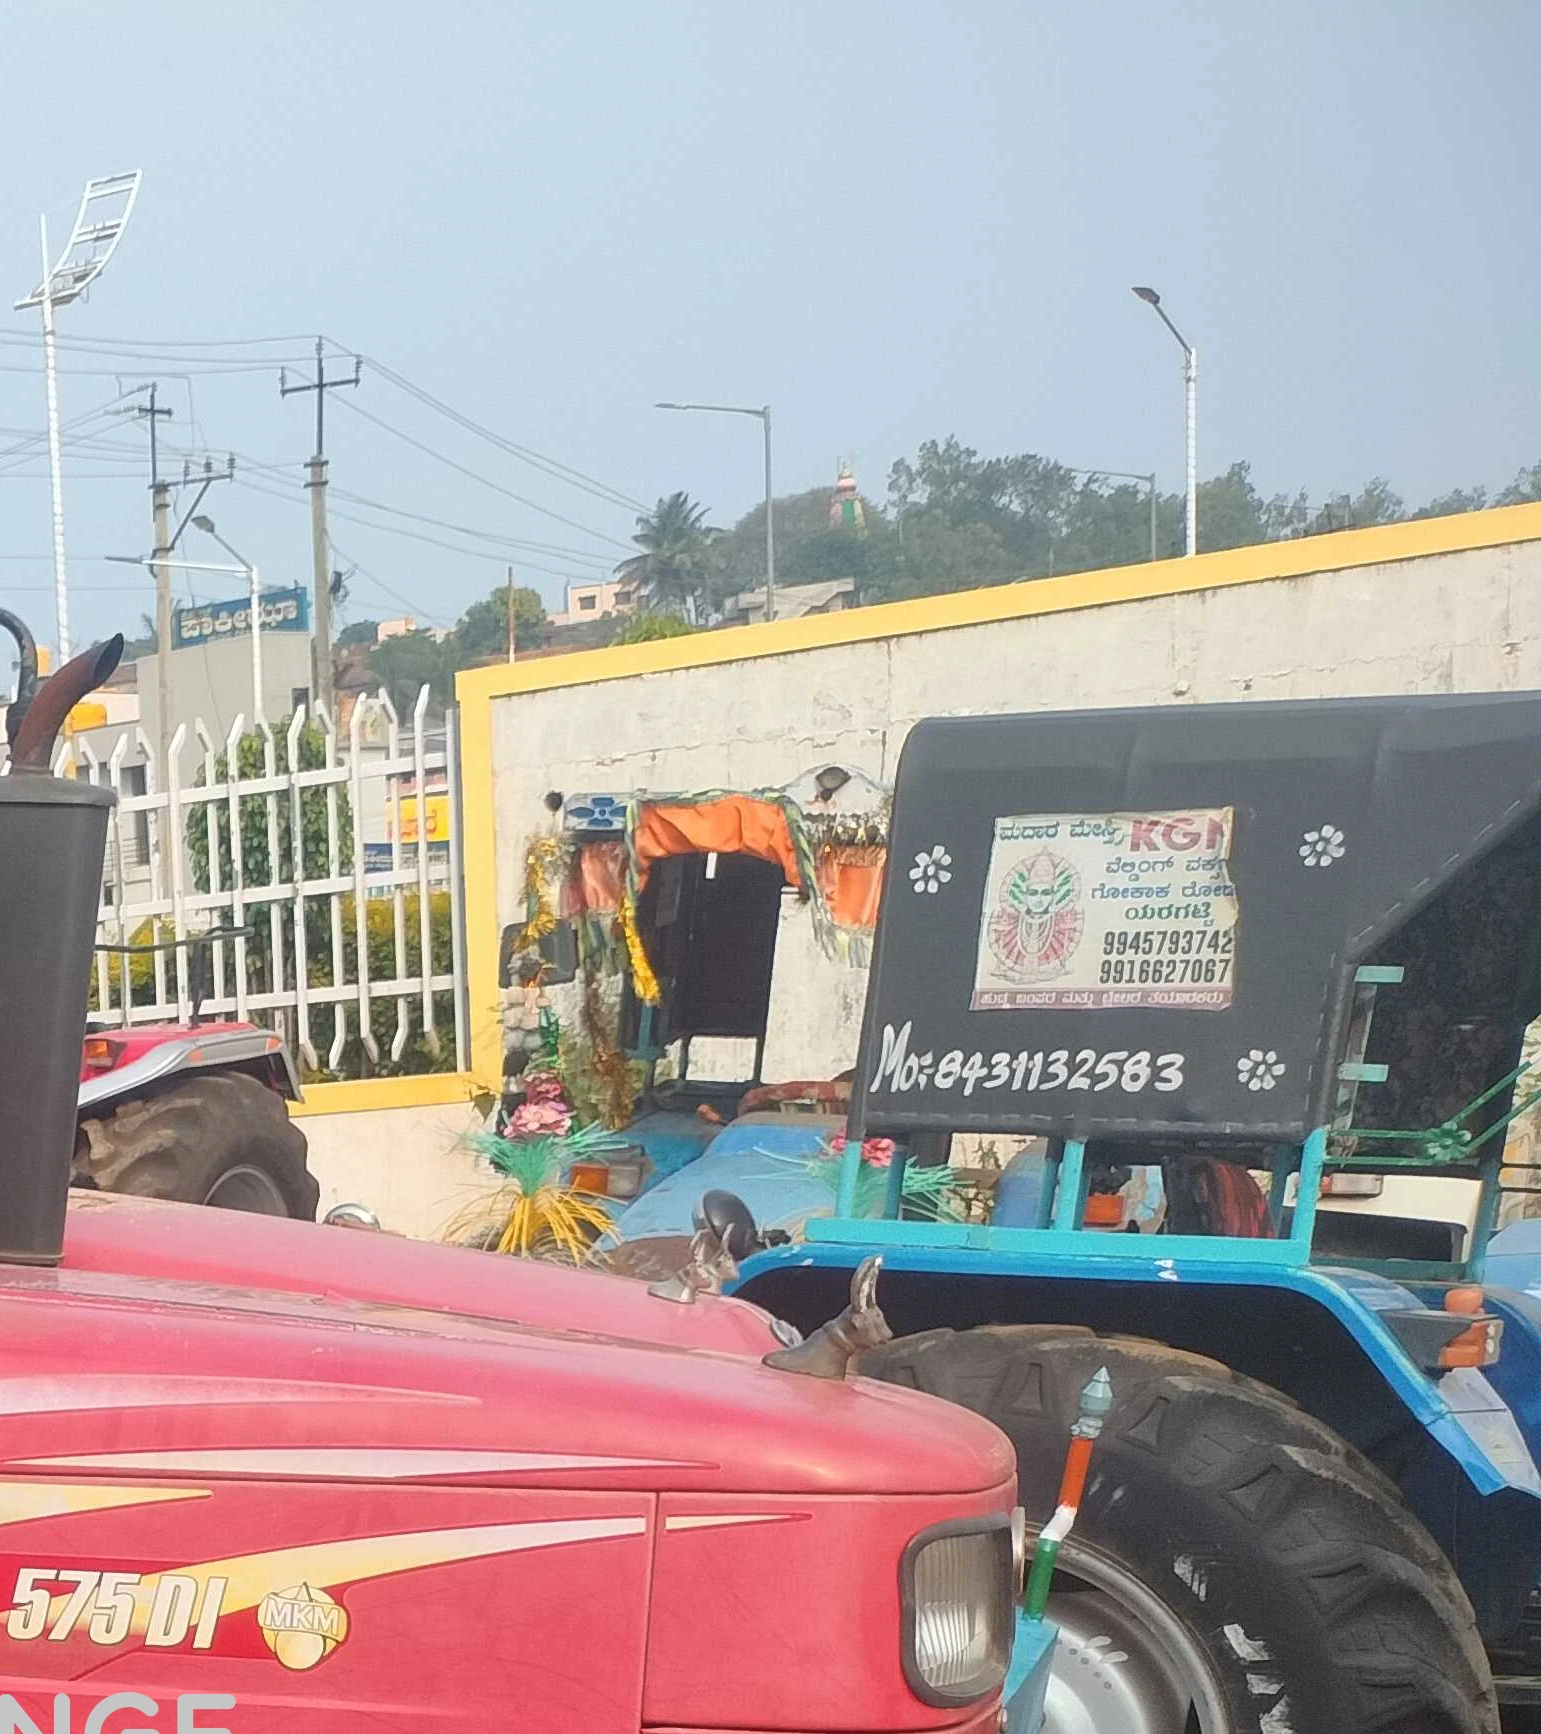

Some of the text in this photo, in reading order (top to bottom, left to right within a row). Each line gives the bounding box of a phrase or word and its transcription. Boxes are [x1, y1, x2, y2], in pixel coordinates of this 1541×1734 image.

[1091, 881, 1172, 900] ಗೋಕಾಕ
[1103, 929, 1233, 956] 9945793742
[1099, 957, 1231, 984] 9916627067
[5, 1567, 143, 1646] 575
[144, 1574, 229, 1650] DI
[264, 1597, 342, 1637] MKM
